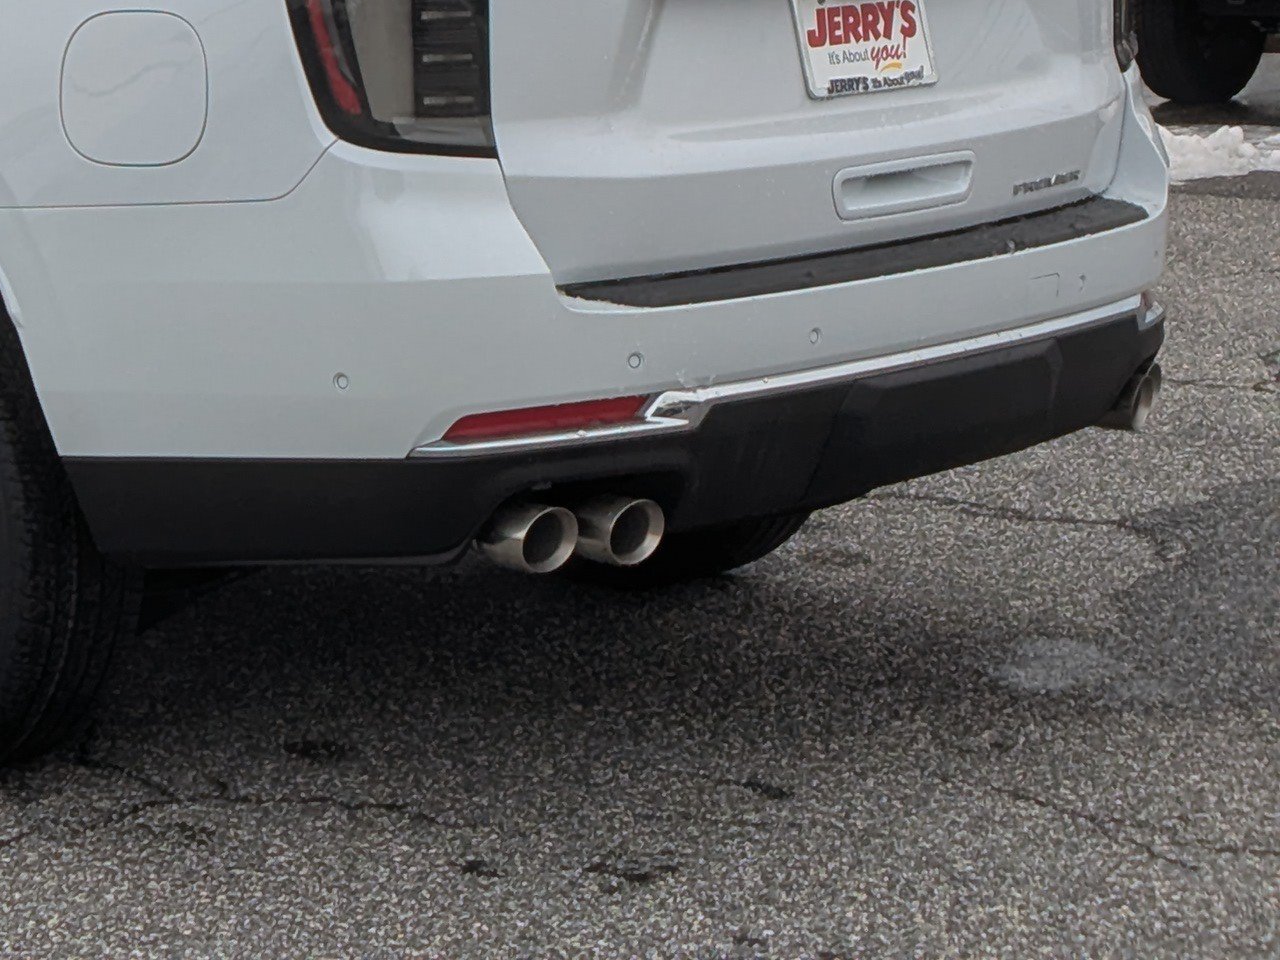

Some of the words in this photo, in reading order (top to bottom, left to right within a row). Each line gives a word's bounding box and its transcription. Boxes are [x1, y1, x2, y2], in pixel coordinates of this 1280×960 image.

[807, 0, 917, 48] JERRY'S
[828, 51, 840, 65] It's
[842, 48, 870, 63] About
